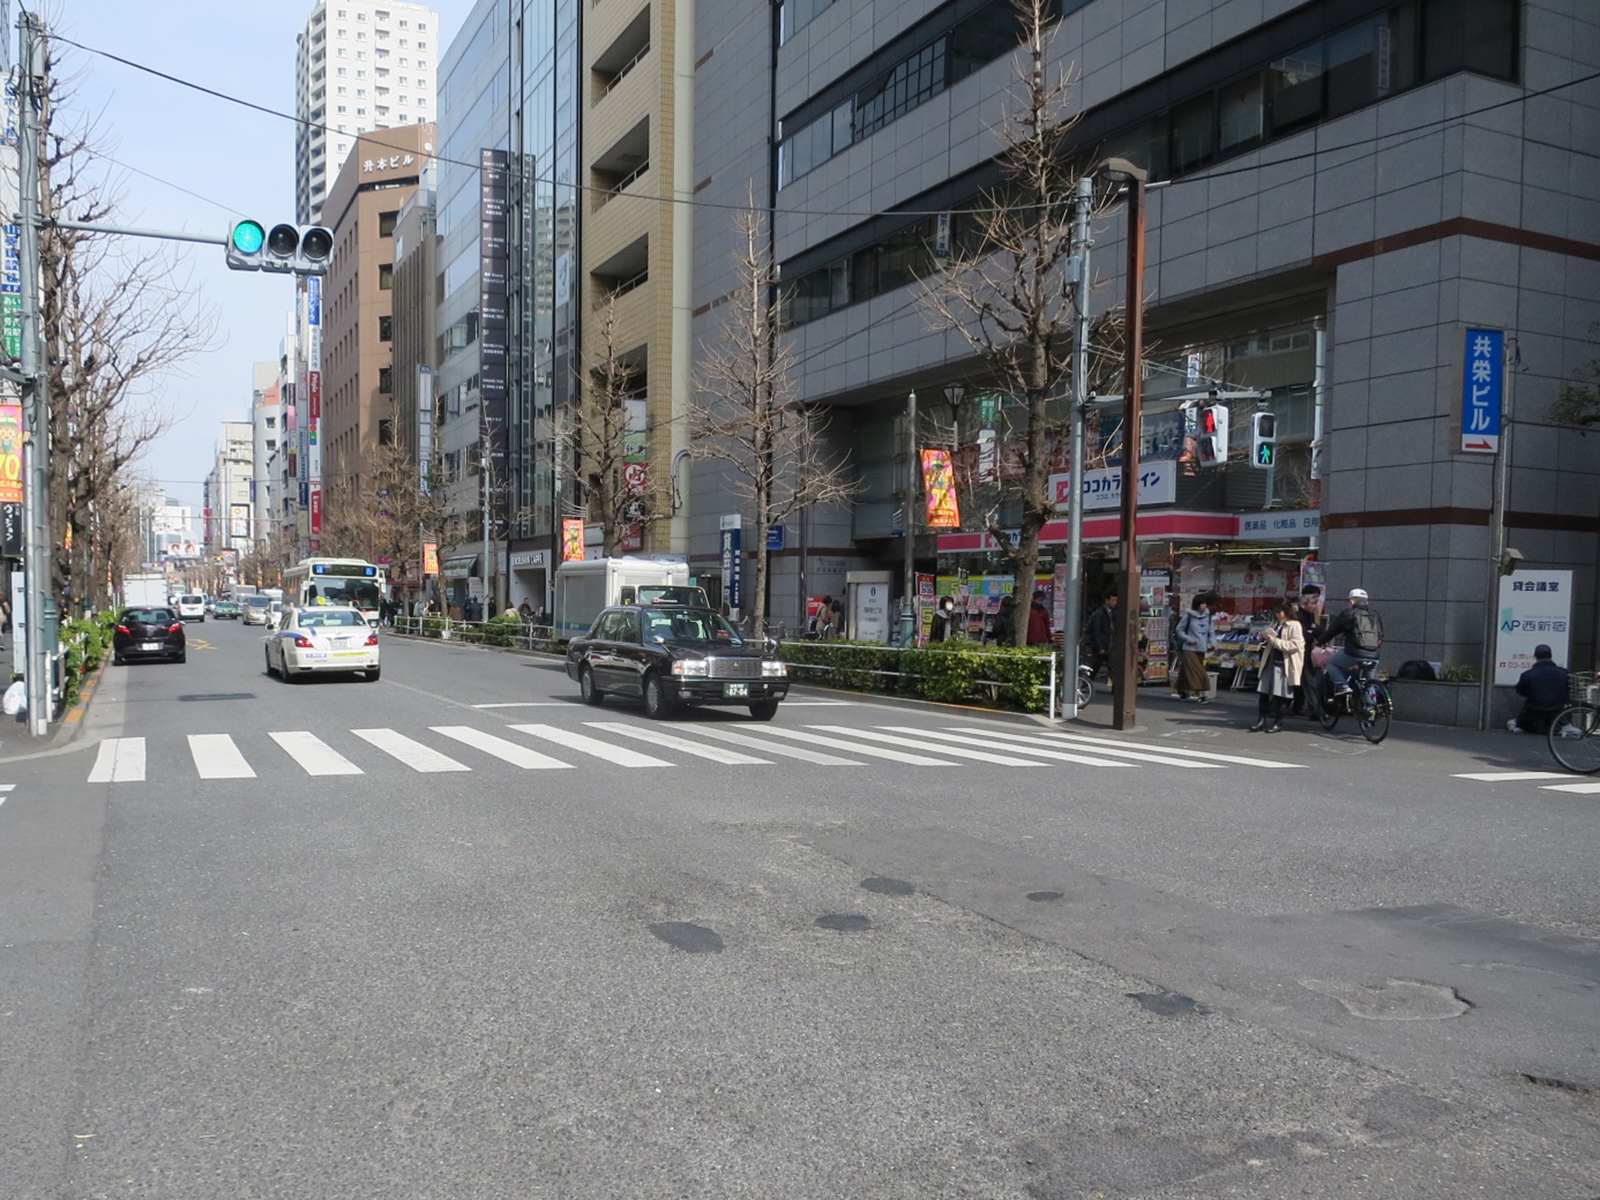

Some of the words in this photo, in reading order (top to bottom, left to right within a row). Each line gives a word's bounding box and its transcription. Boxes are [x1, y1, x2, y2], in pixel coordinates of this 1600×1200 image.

[1470, 335, 1492, 431] 共栄ビル
[1244, 520, 1267, 531] 医薬品
[1273, 518, 1296, 530] 化粧品
[1512, 581, 1559, 592] 貸会議室
